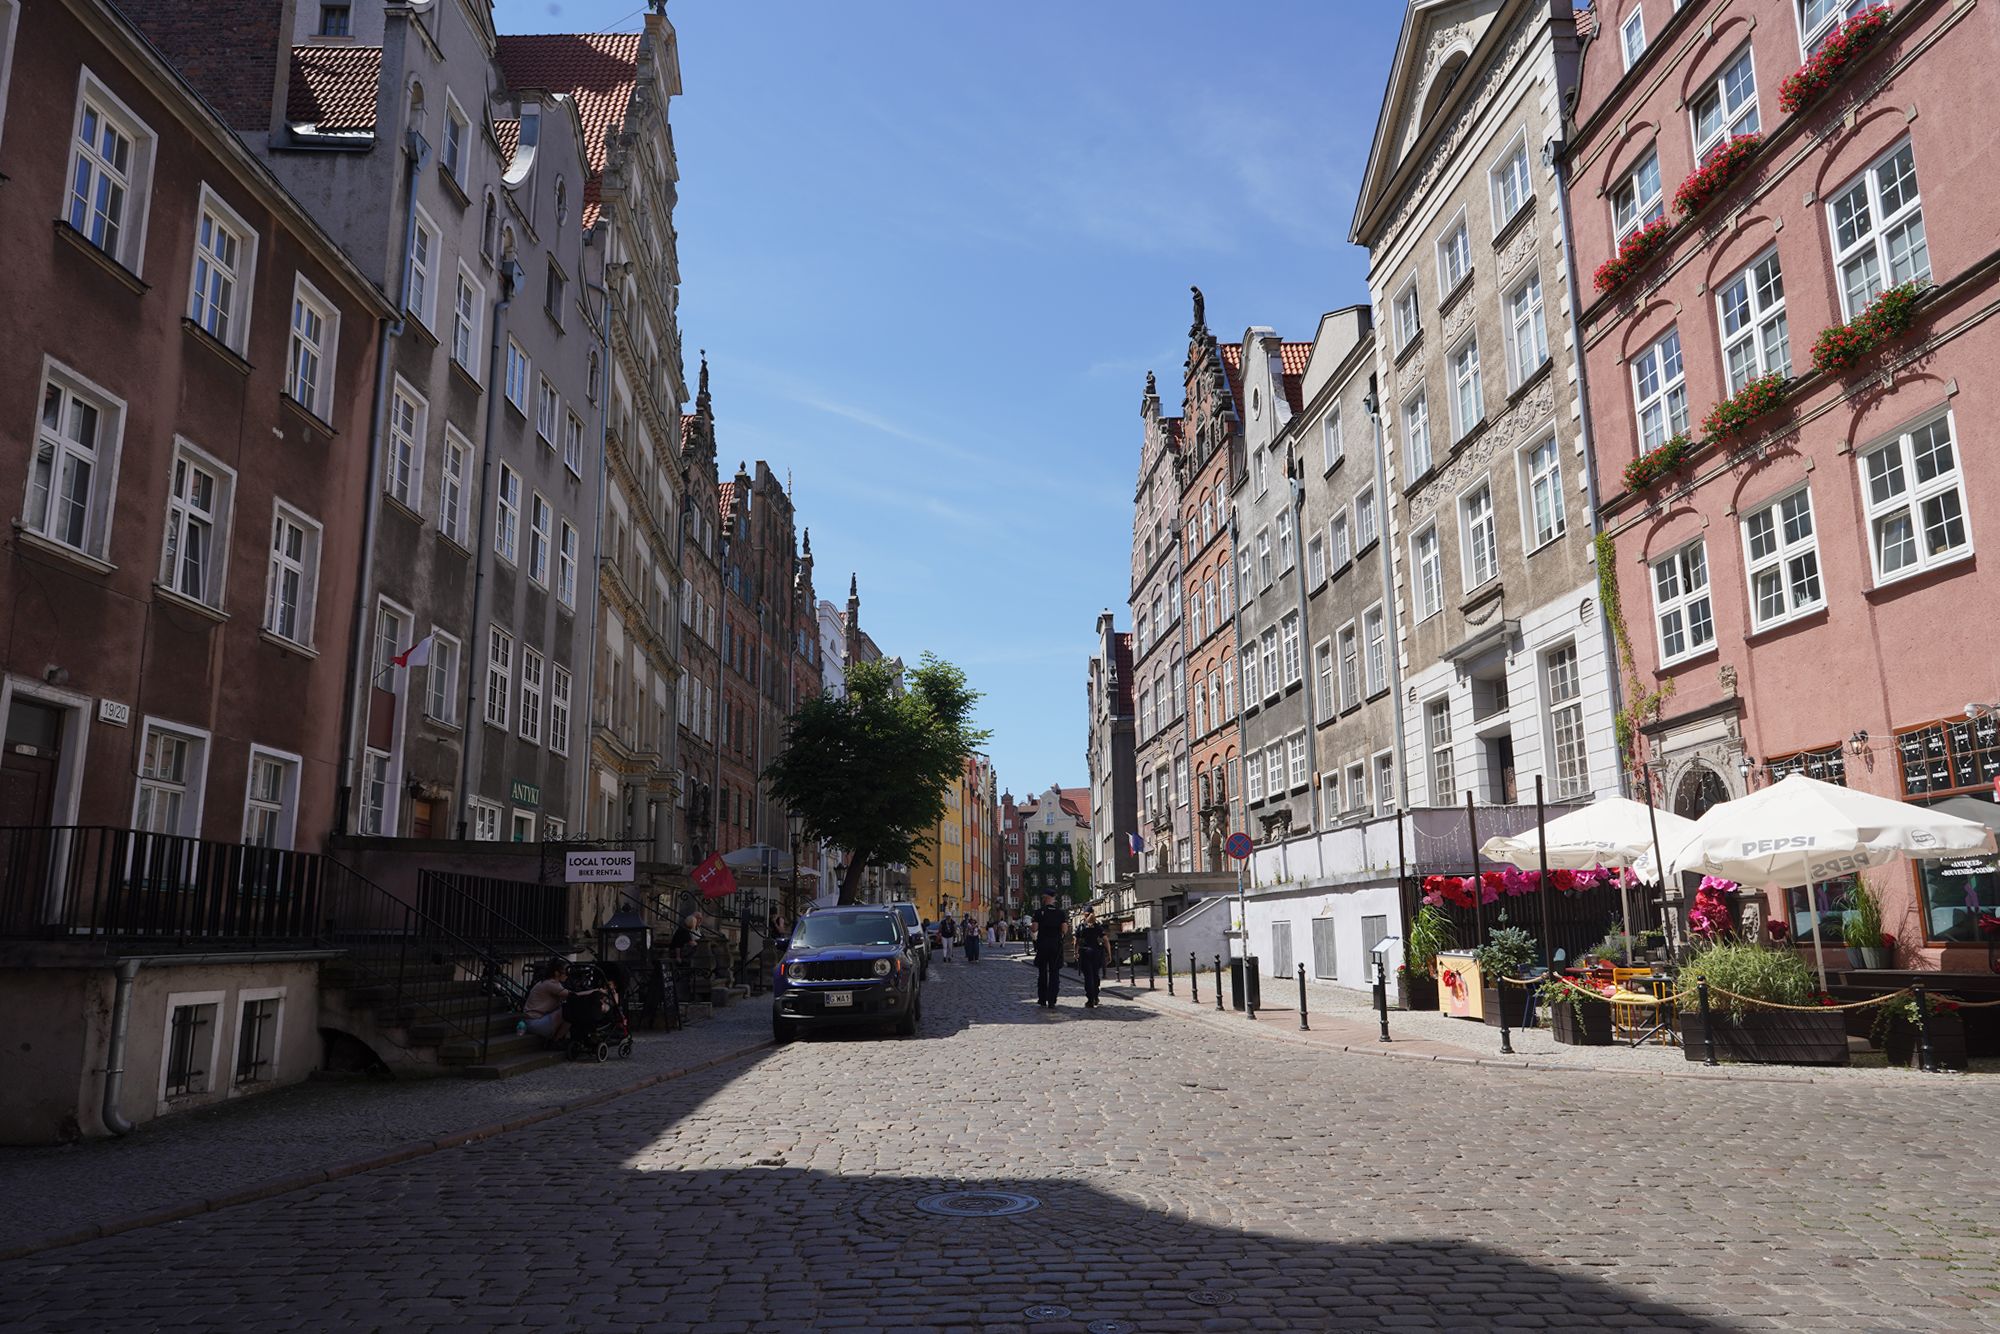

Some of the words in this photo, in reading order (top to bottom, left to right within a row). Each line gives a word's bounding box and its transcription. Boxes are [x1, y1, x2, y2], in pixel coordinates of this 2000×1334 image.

[105, 702, 126, 720] 19/20
[511, 783, 539, 804] ANTYKI
[1742, 836, 1816, 856] PEPSI
[569, 857, 598, 866] LOCAL
[601, 857, 632, 866] TOURS
